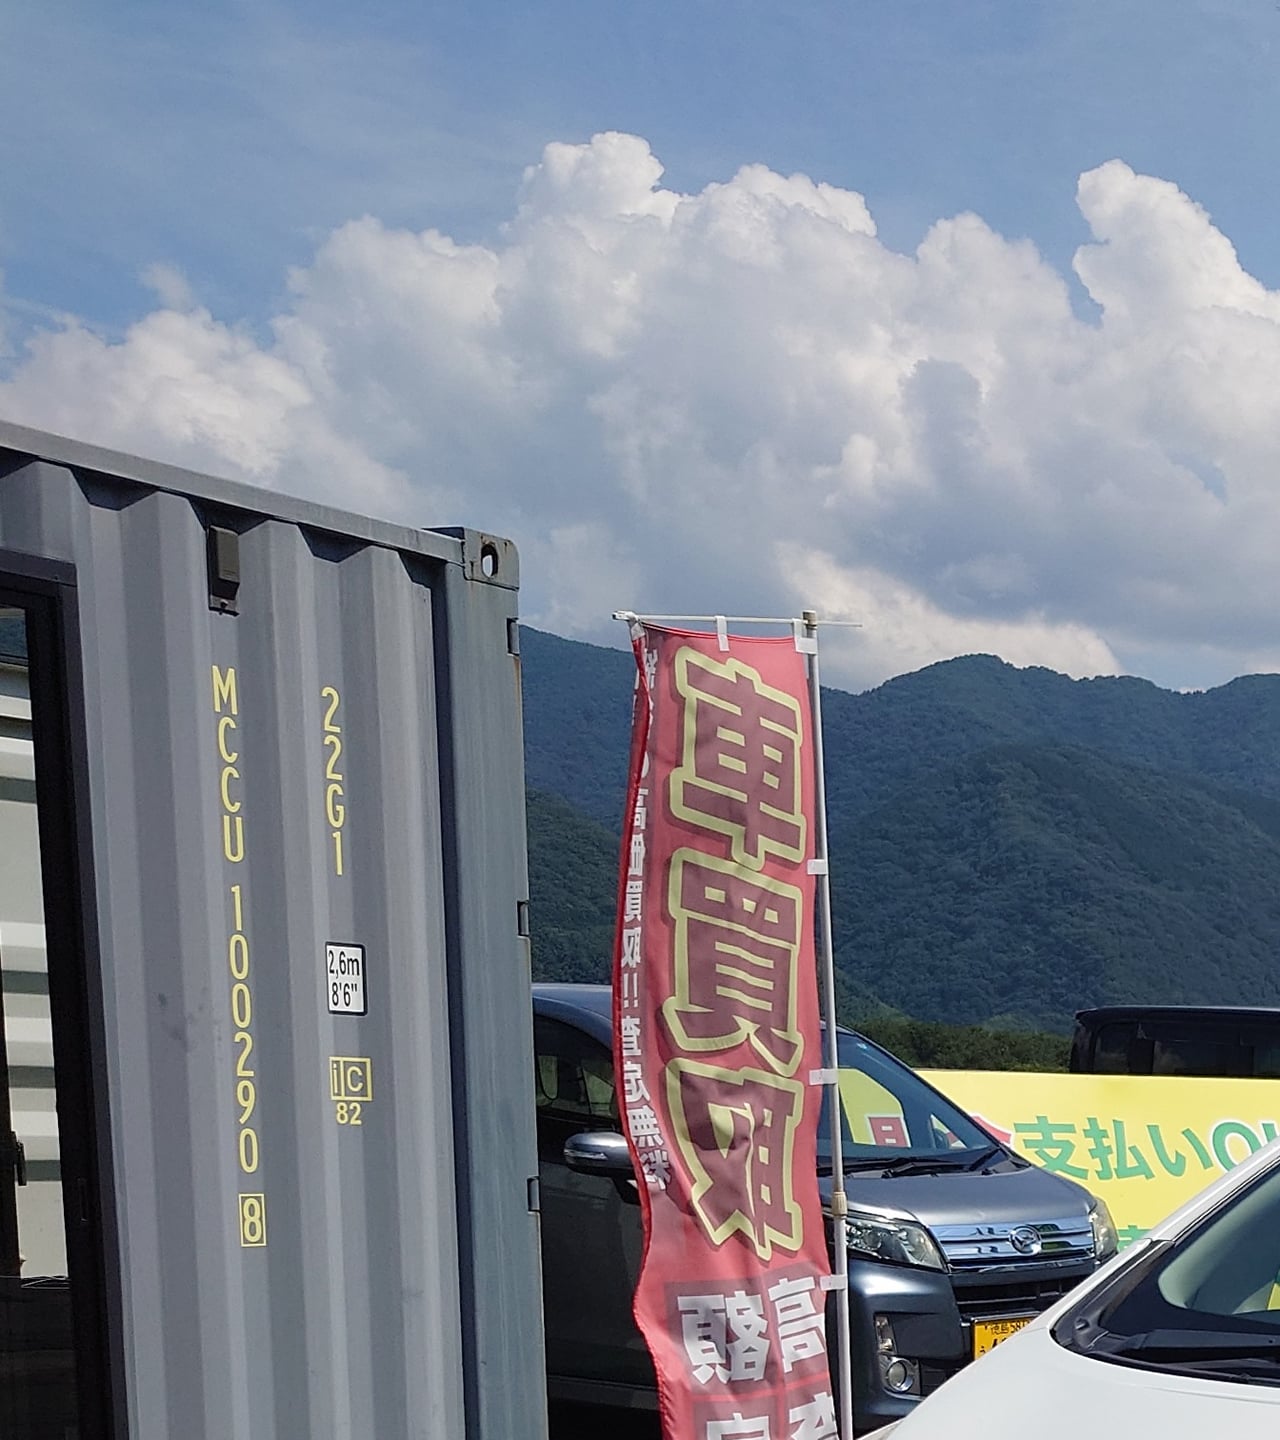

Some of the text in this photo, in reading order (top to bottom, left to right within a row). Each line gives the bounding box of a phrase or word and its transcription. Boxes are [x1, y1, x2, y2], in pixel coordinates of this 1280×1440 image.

[321, 686, 345, 876] 22G1
[211, 665, 245, 863] MCCU
[230, 884, 259, 1174] 100290
[336, 1103, 362, 1126] 82
